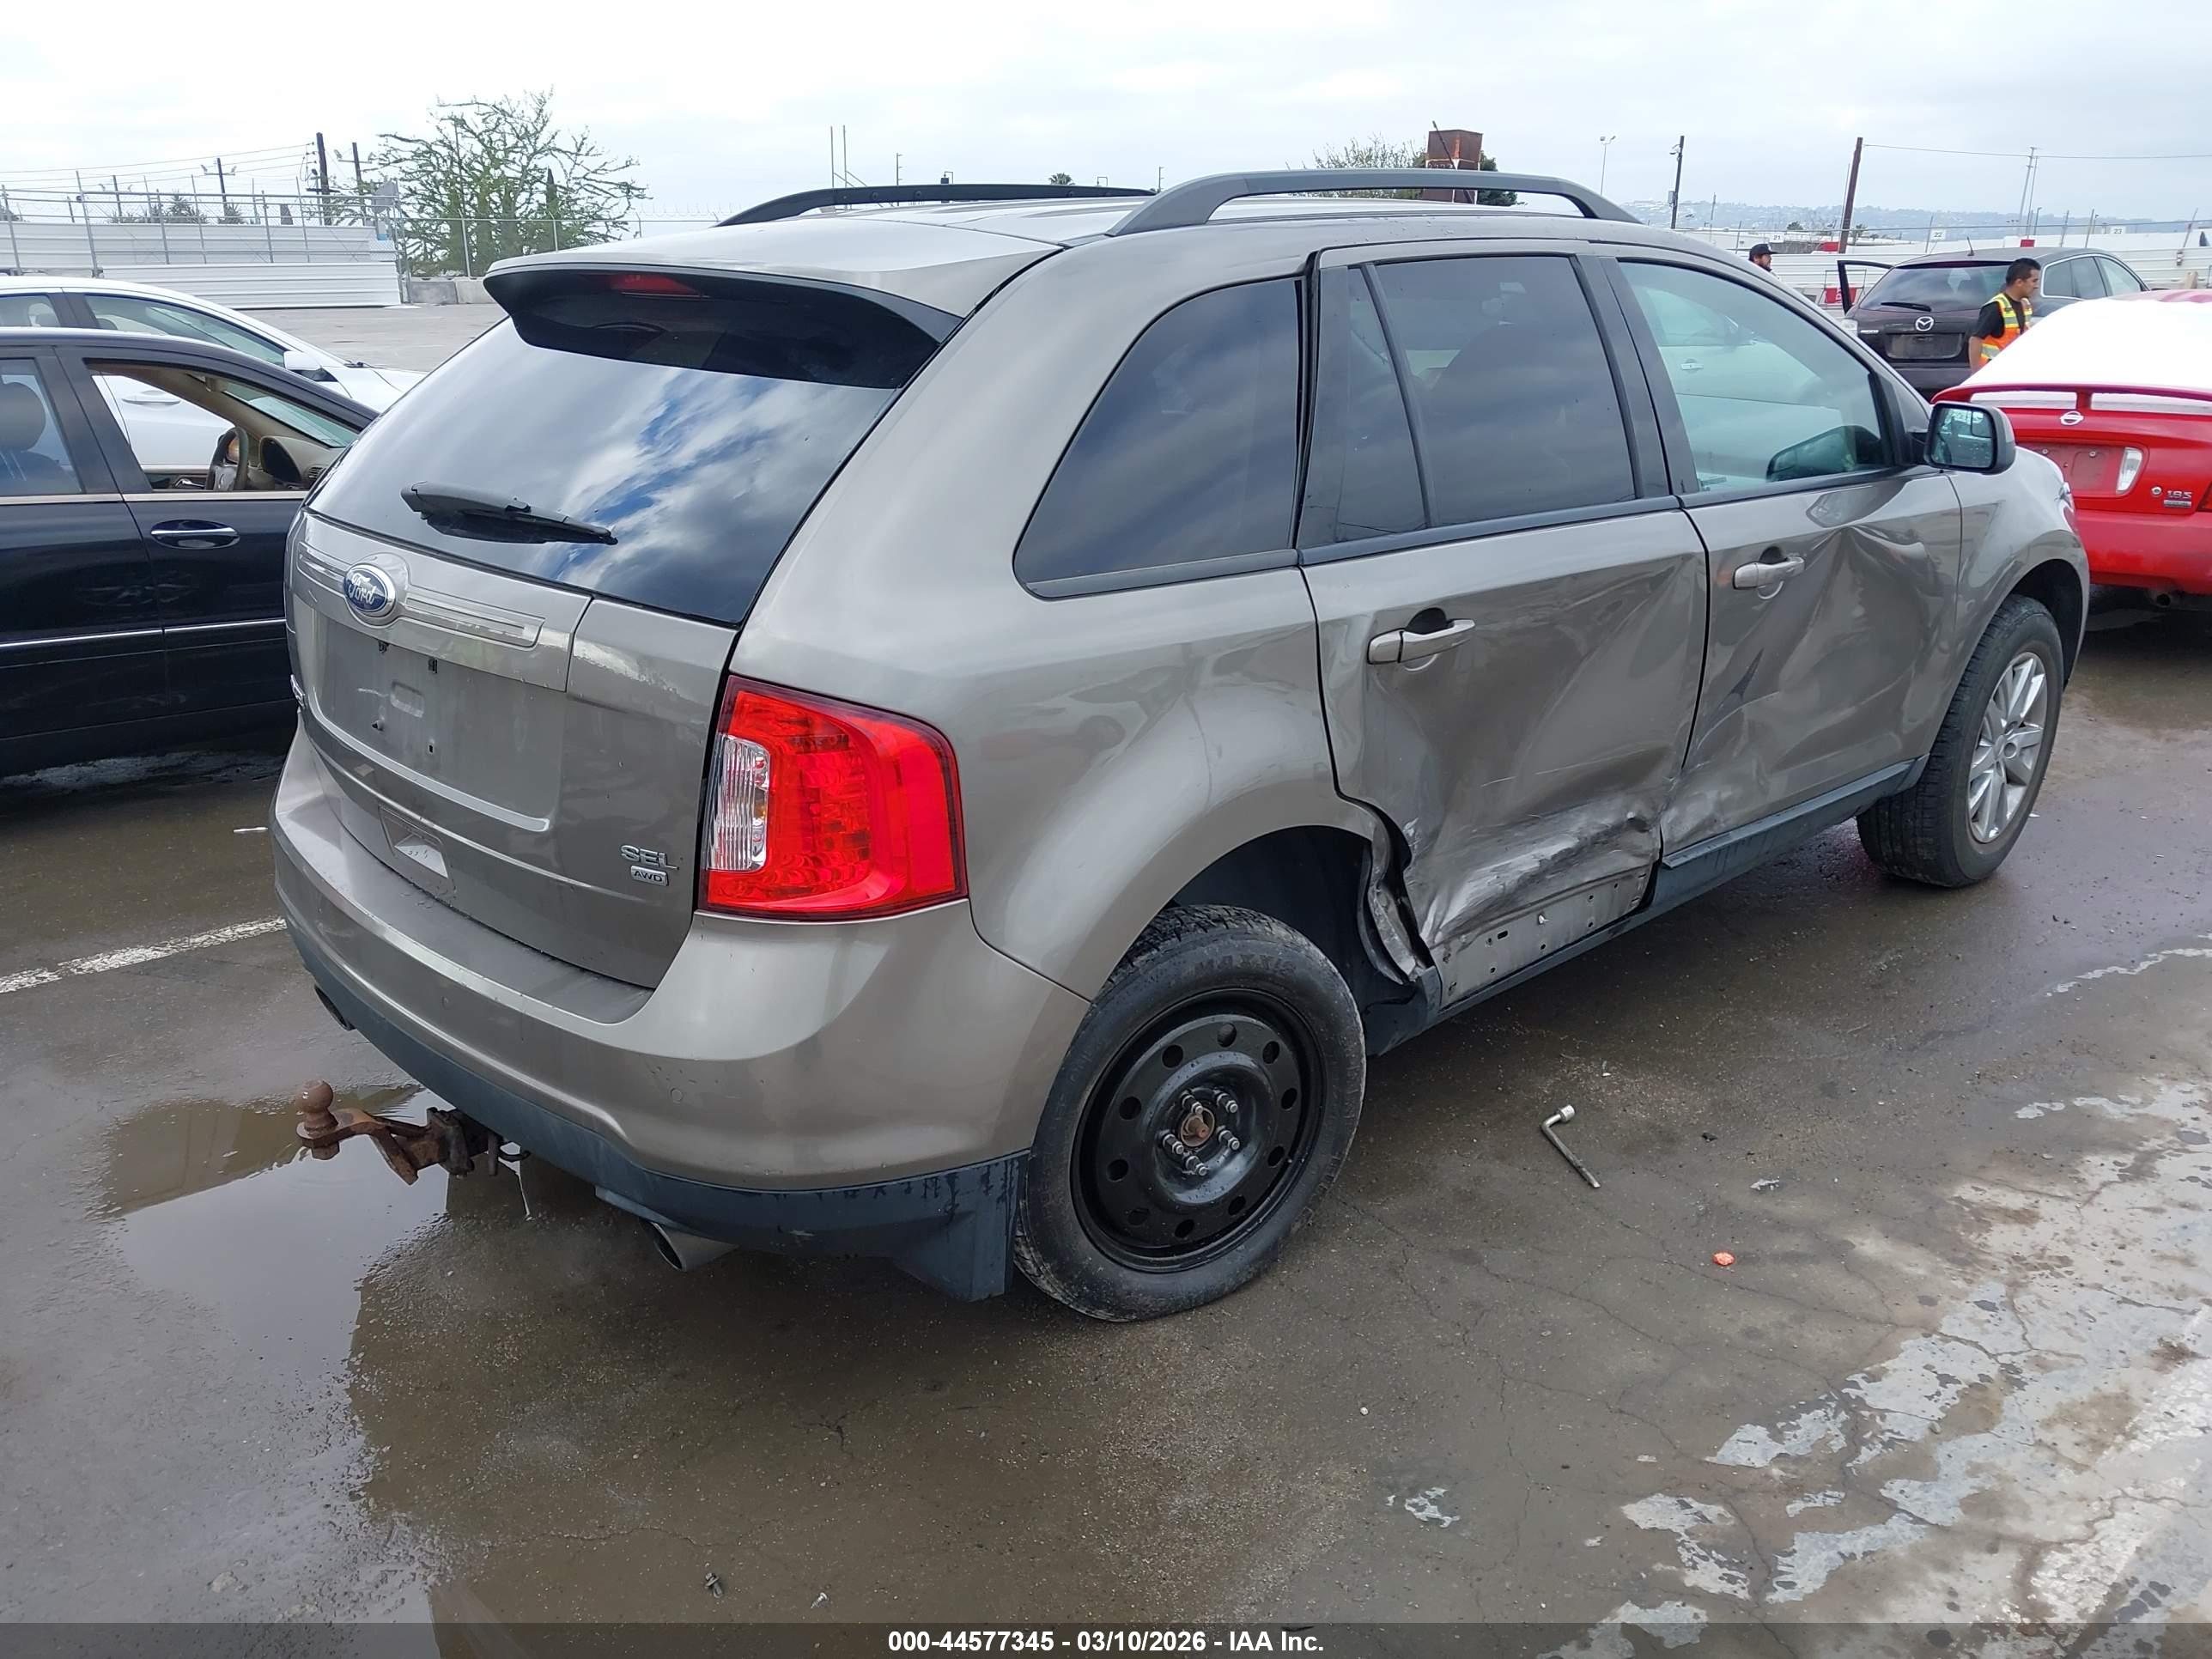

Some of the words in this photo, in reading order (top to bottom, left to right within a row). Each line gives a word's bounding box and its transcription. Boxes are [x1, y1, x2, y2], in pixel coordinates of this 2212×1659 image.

[349, 572, 377, 605] Ford
[620, 845, 679, 869] SEL
[634, 871, 663, 882] AWD
